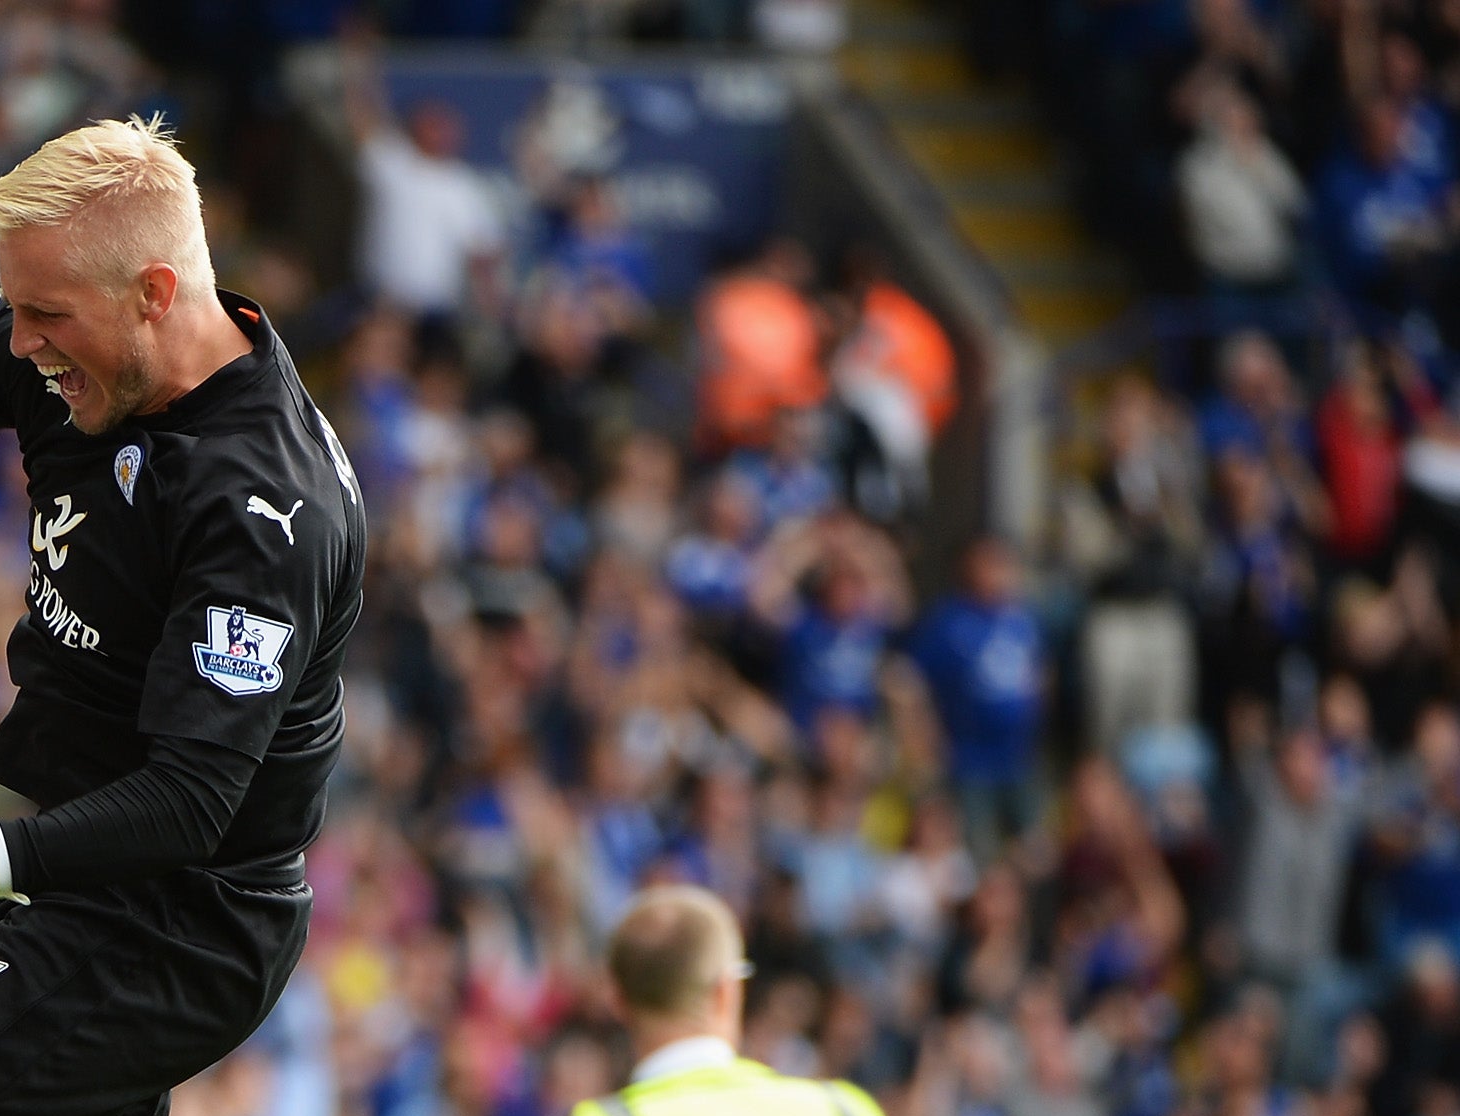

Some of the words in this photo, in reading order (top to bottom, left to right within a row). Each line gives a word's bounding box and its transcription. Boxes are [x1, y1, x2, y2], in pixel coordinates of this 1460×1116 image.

[35, 574, 108, 656] POWER
[207, 664, 234, 673] PREMIER
[234, 669, 259, 680] LEAGUE
[209, 655, 261, 674] BARCLAYS
